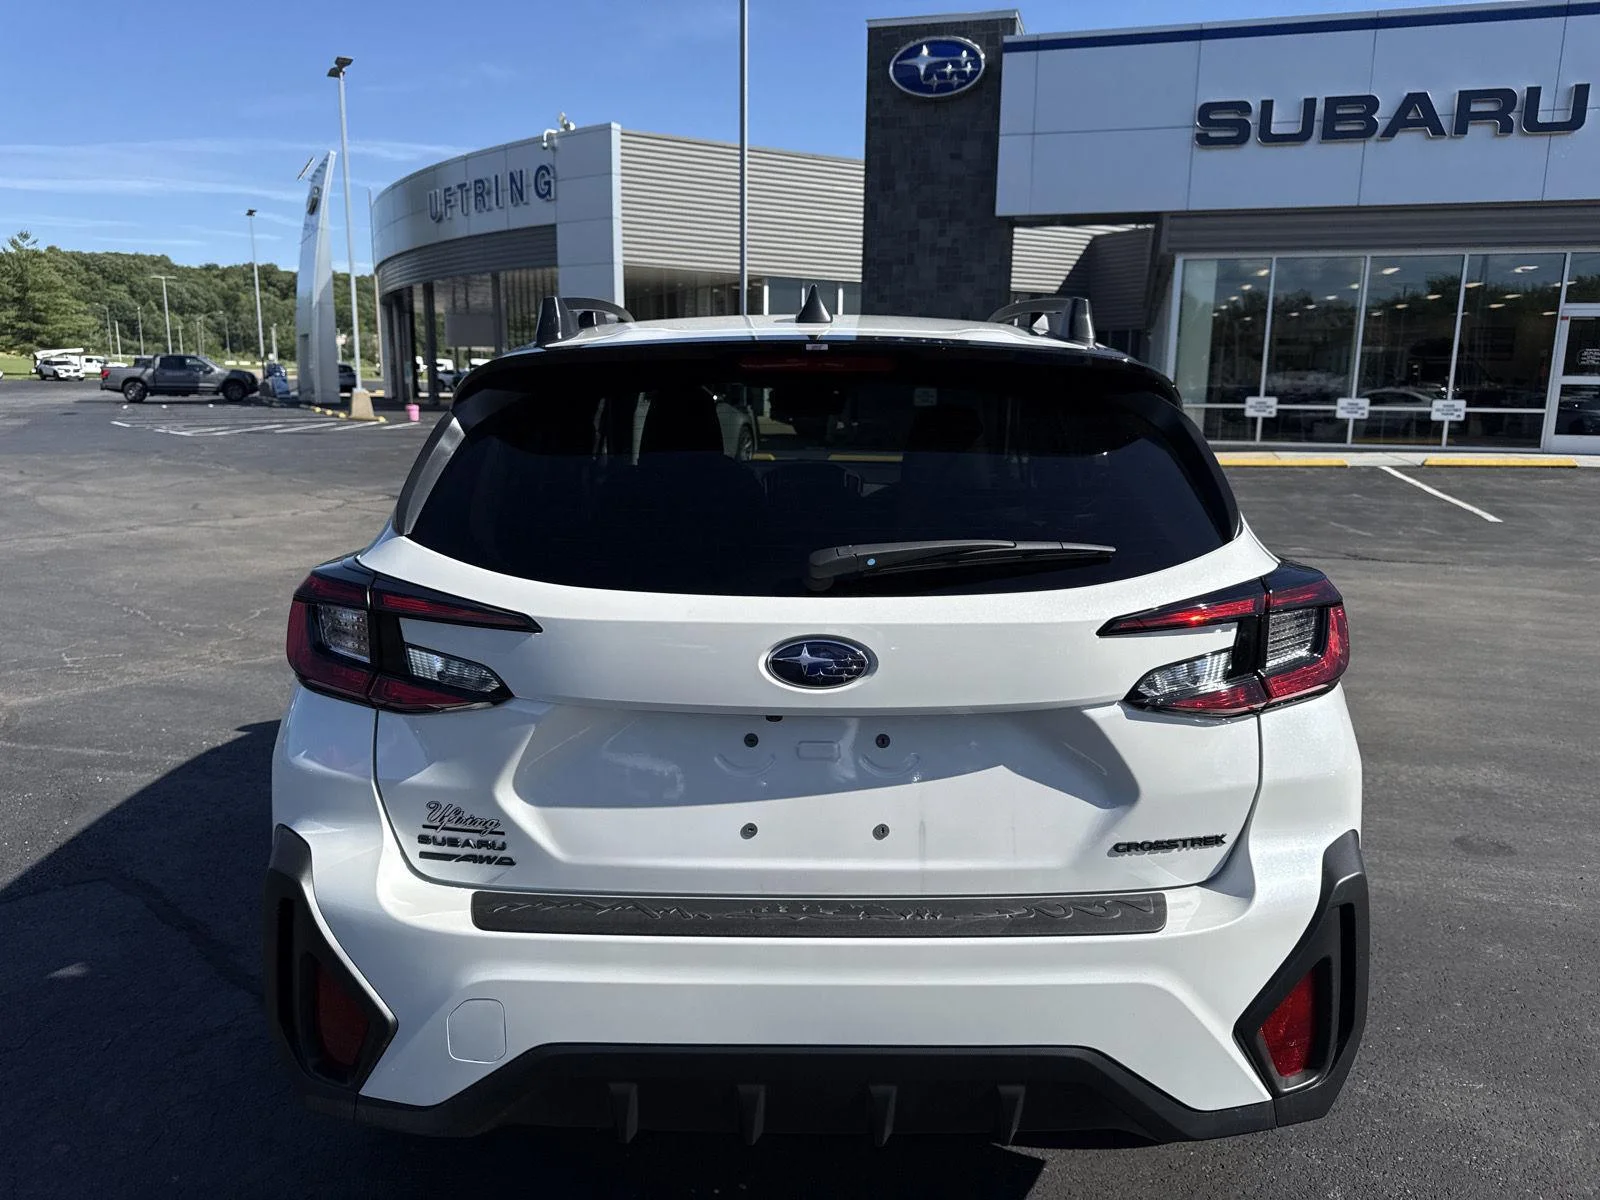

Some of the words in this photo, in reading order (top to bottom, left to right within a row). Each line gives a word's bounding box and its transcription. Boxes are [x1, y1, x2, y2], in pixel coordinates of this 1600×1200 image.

[1195, 83, 1591, 147] SUBARU
[428, 163, 555, 223] UFTRING
[425, 800, 501, 837] Uftring
[417, 834, 507, 851] SUBARU
[1111, 833, 1227, 854] CROSSTREK
[454, 854, 516, 866] AWD
